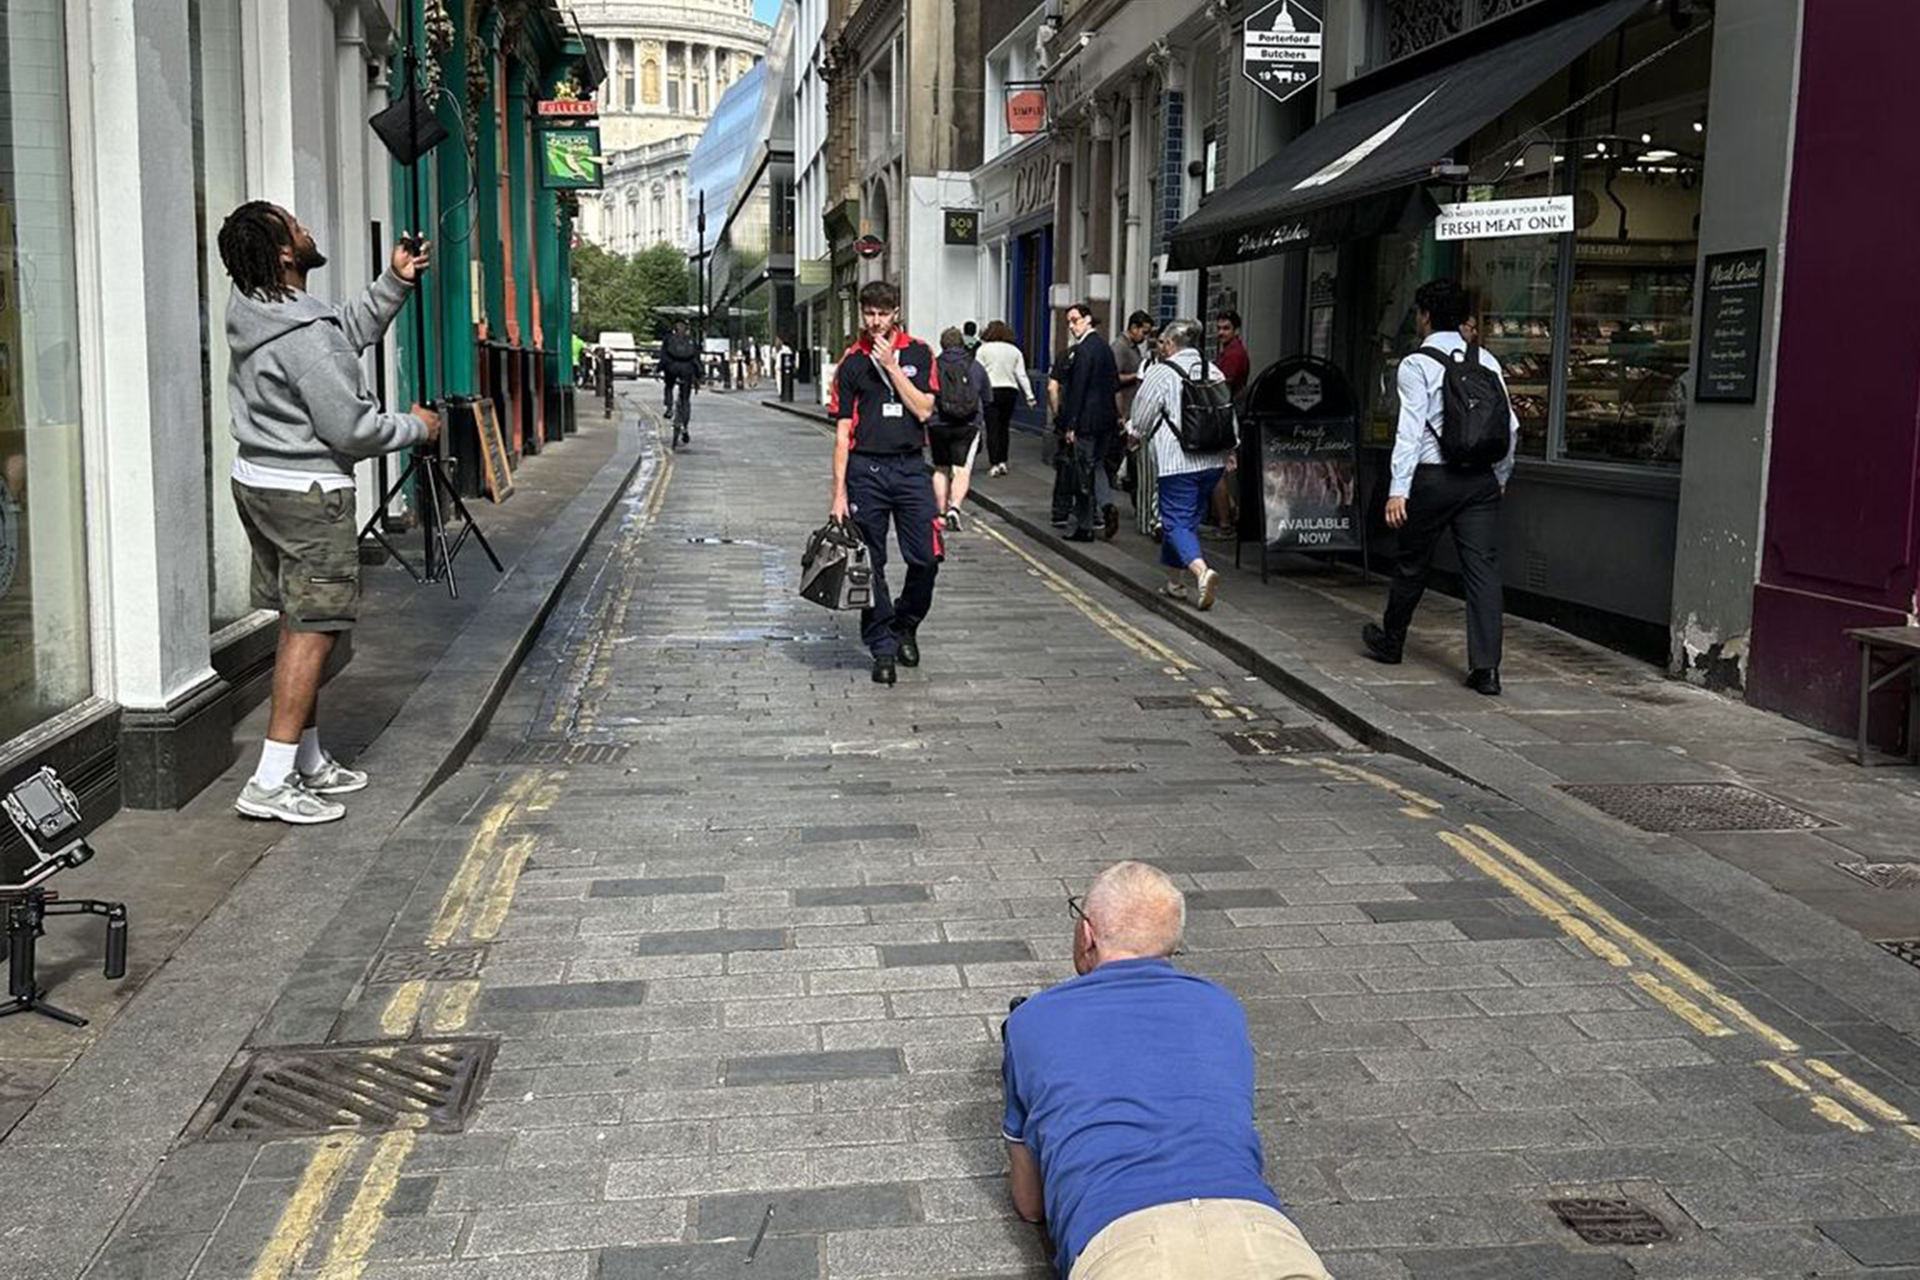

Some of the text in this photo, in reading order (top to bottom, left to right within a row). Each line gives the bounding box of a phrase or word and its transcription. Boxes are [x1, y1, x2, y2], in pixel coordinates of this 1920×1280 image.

[1258, 33, 1311, 44] Porterford
[1260, 49, 1307, 59] Butchers
[1258, 71, 1307, 82] 19 83
[1012, 106, 1041, 116] SIMPLE
[1474, 208, 1485, 217] TO
[1518, 205, 1538, 214] YOUR
[1441, 215, 1567, 236] FRESH MEAT ONLY
[1576, 244, 1631, 255] DELIVERY
[1269, 437, 1353, 455] Spring Lamb
[1278, 517, 1350, 531] AVAILABLE
[1298, 532, 1331, 544] NOW
